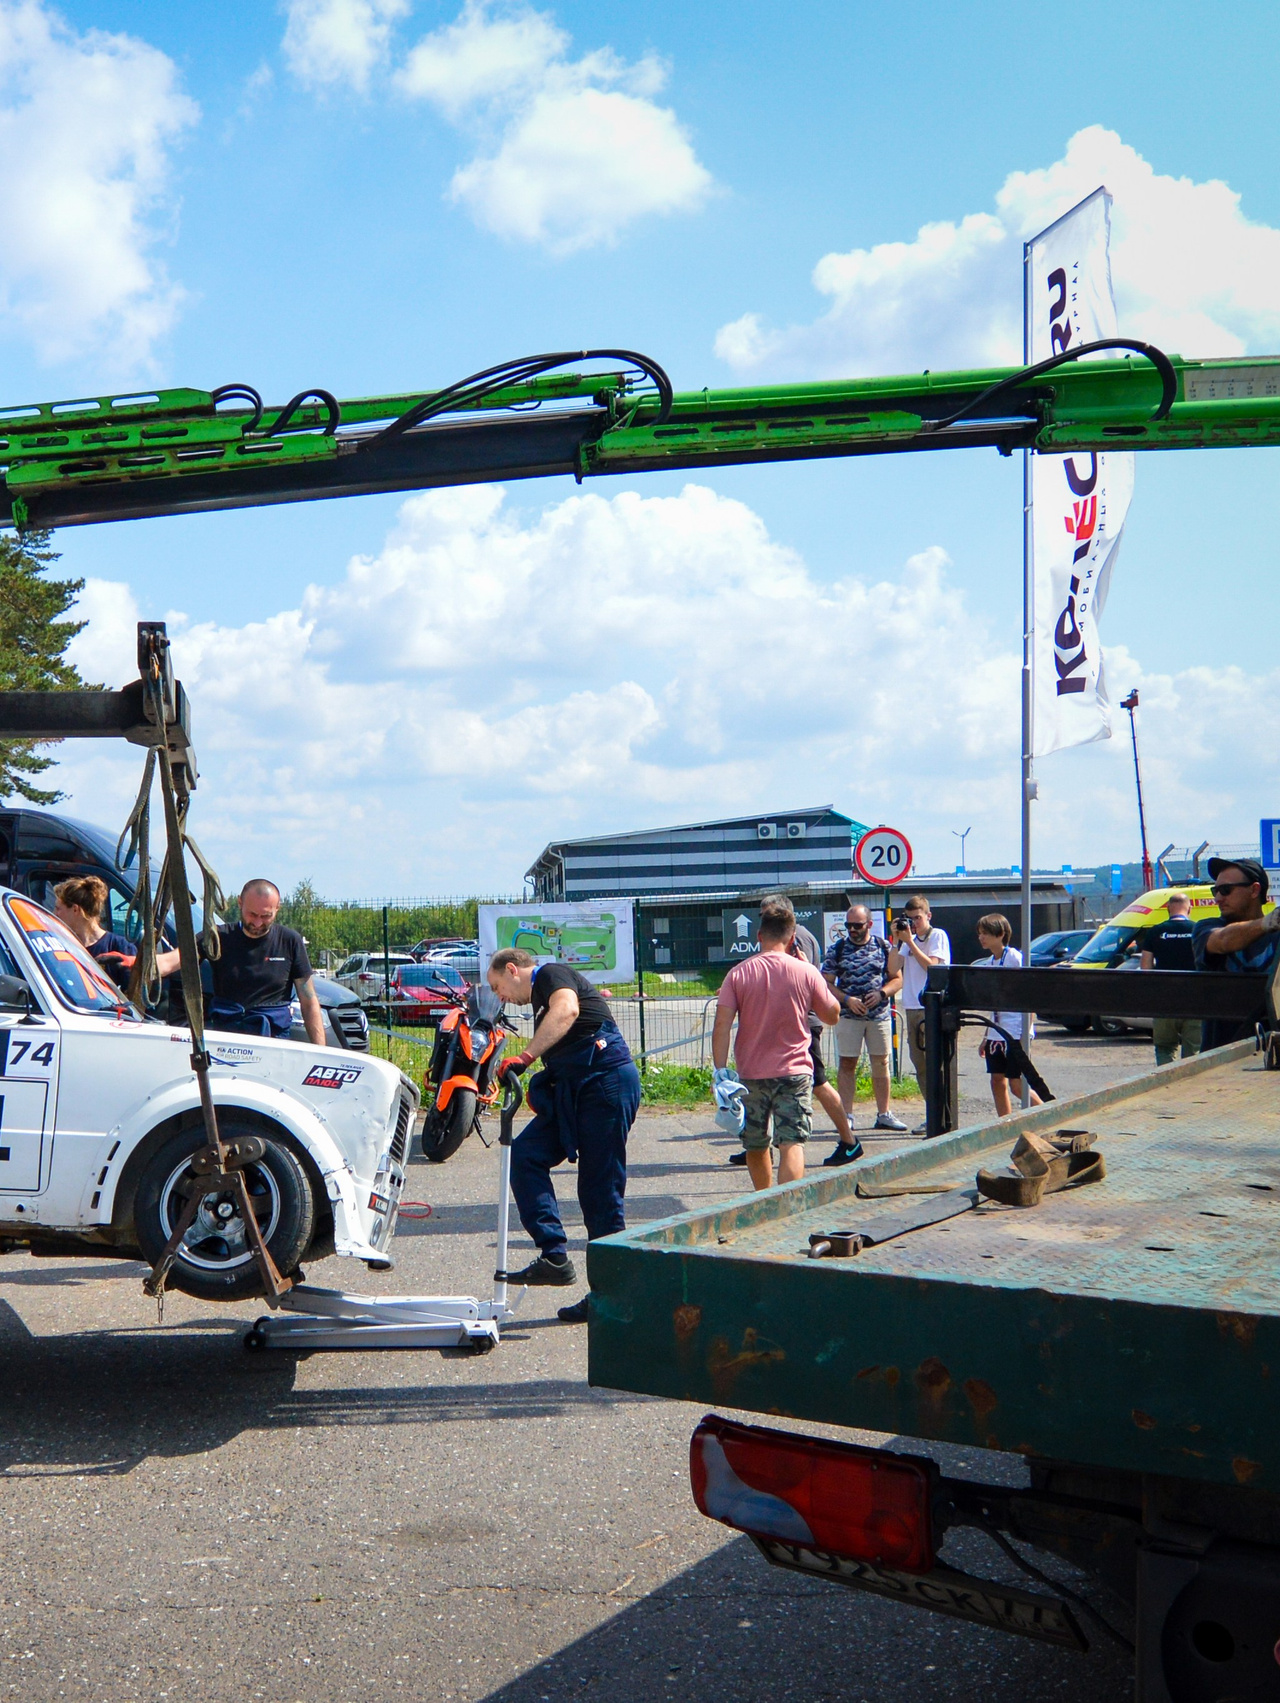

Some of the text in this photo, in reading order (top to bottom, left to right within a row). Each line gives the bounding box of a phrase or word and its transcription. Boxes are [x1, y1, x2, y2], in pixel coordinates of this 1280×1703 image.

[871, 844, 901, 867] 20
[9, 1041, 56, 1067] 74
[305, 1077, 340, 1088] ПЛЮС
[309, 1066, 358, 1082] АВТО
